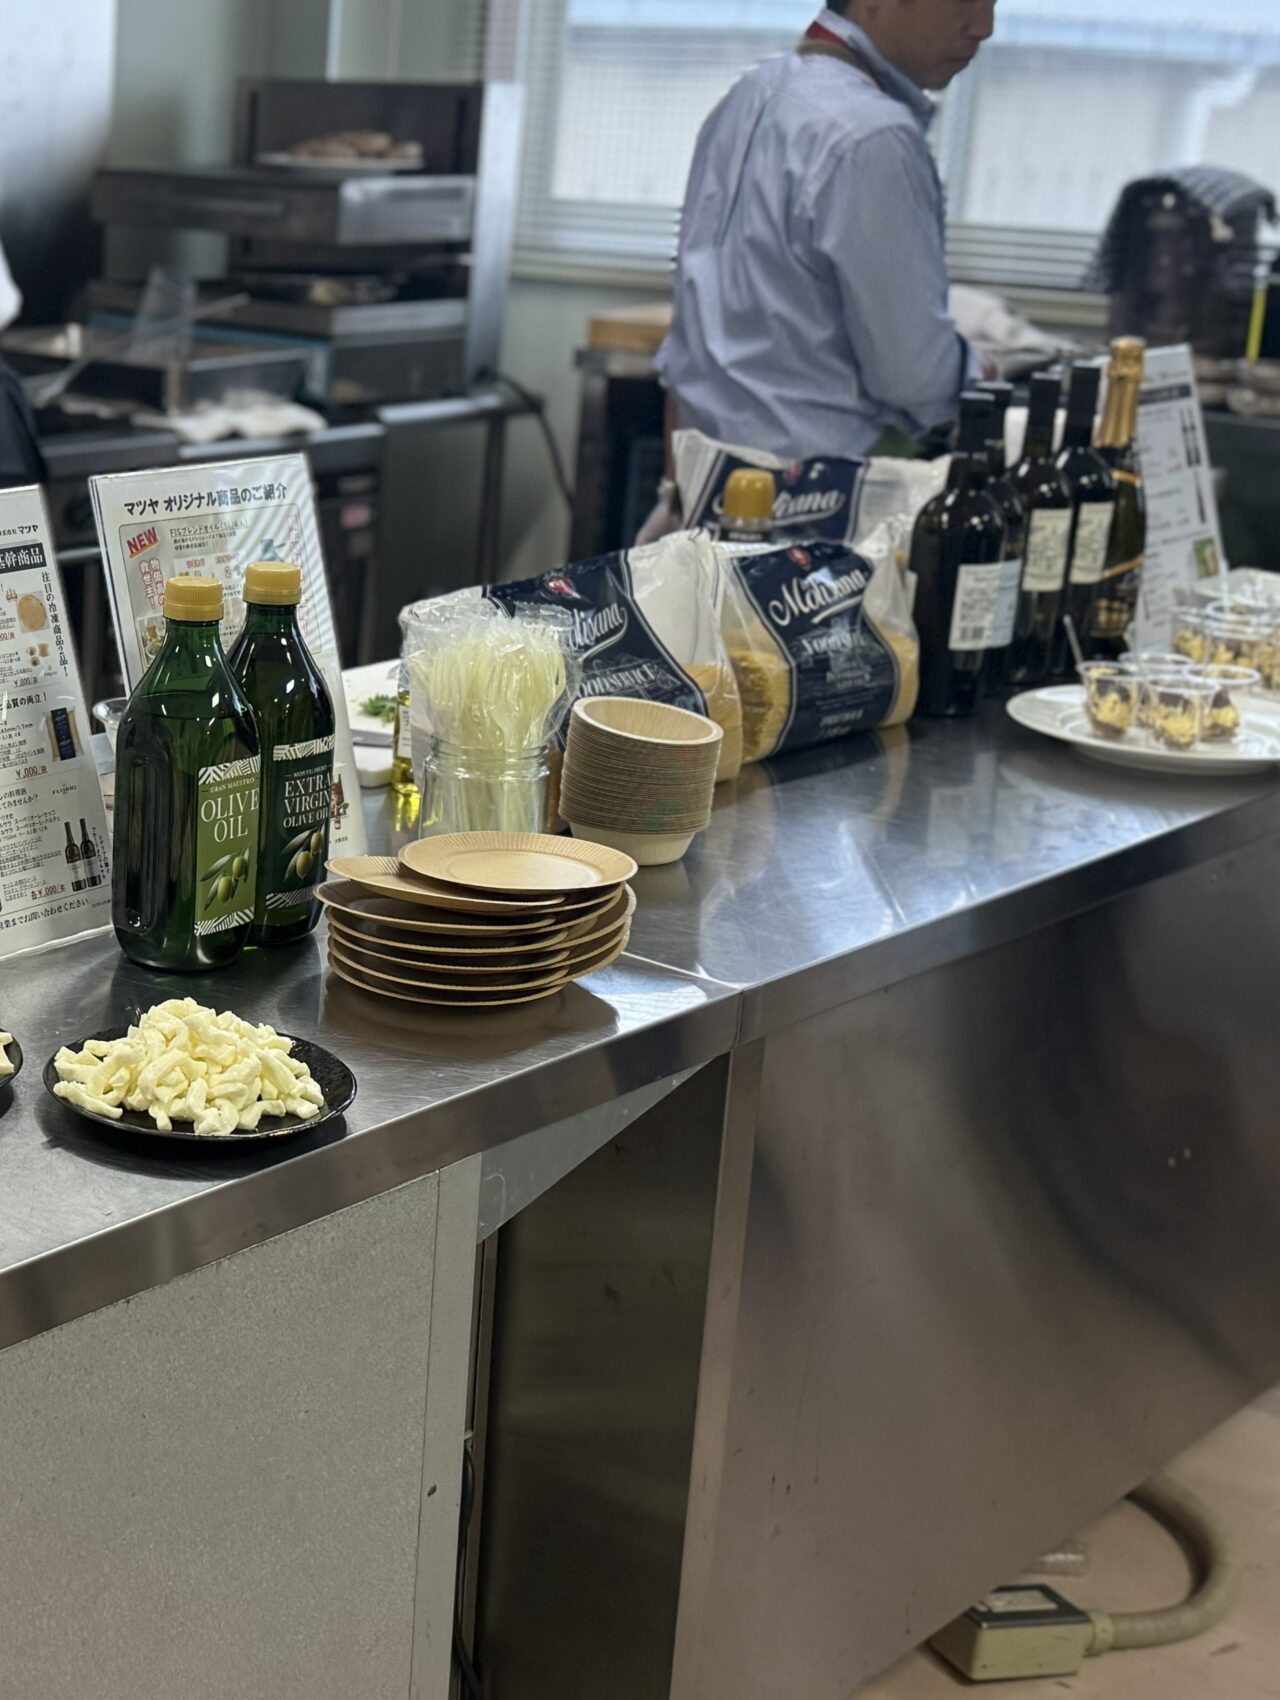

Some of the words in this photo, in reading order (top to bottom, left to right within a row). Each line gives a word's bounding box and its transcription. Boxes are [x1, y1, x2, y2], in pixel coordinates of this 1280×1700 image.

[124, 498, 160, 516] マツヤ
[164, 483, 287, 512] オリジナル商品のご紹介
[127, 527, 158, 553] NEW
[140, 559, 156, 610] 救世主！
[579, 663, 656, 698] OODSERVICE
[284, 773, 332, 798] EXTRA
[201, 788, 259, 823] OLIVE
[284, 791, 332, 815] VIRGIN
[214, 815, 248, 843] OIL
[283, 813, 315, 829] OLIVE
